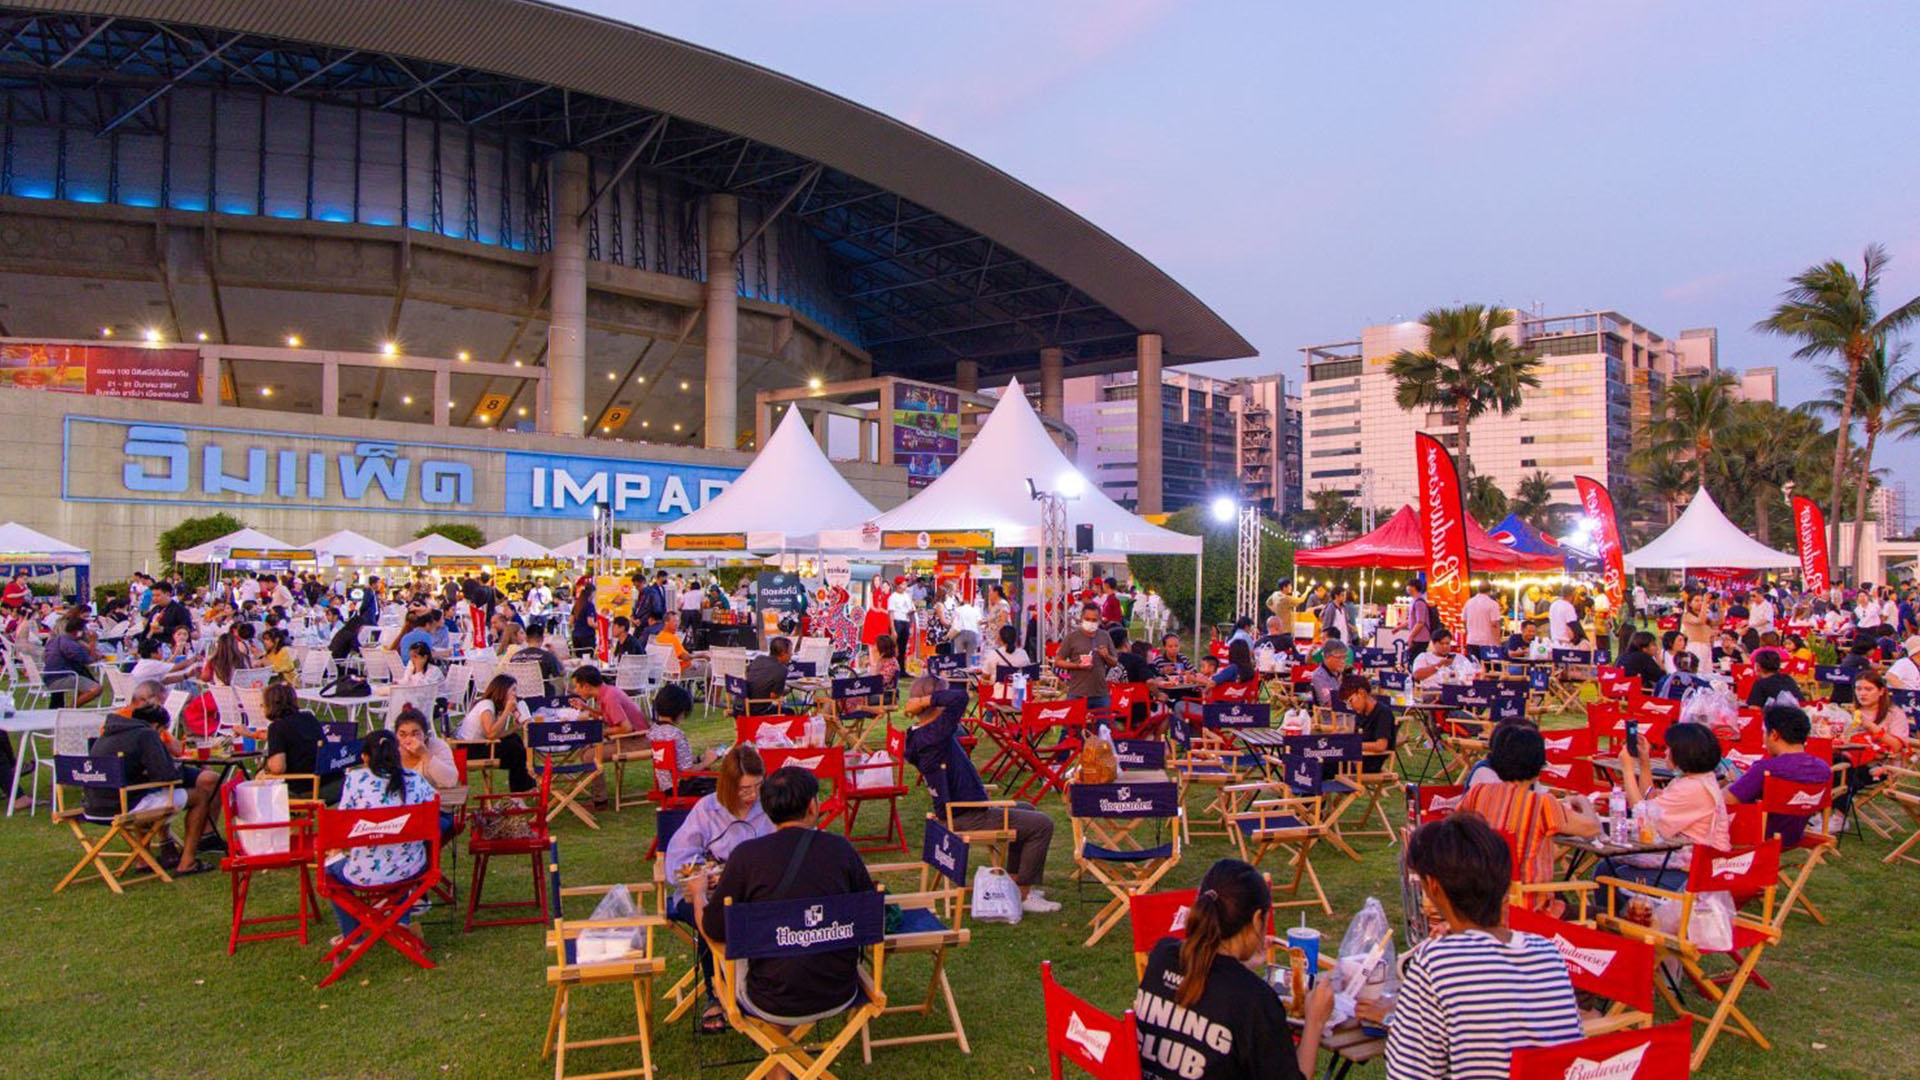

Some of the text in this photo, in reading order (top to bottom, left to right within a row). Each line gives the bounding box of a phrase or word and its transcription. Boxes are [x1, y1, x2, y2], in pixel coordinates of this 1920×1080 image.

[486, 399, 499, 410] 8
[609, 412, 621, 422] 9
[123, 425, 474, 505] อิมแพ็ค
[1426, 447, 1462, 594] Budweiser
[776, 921, 853, 947] Hoegaarden
